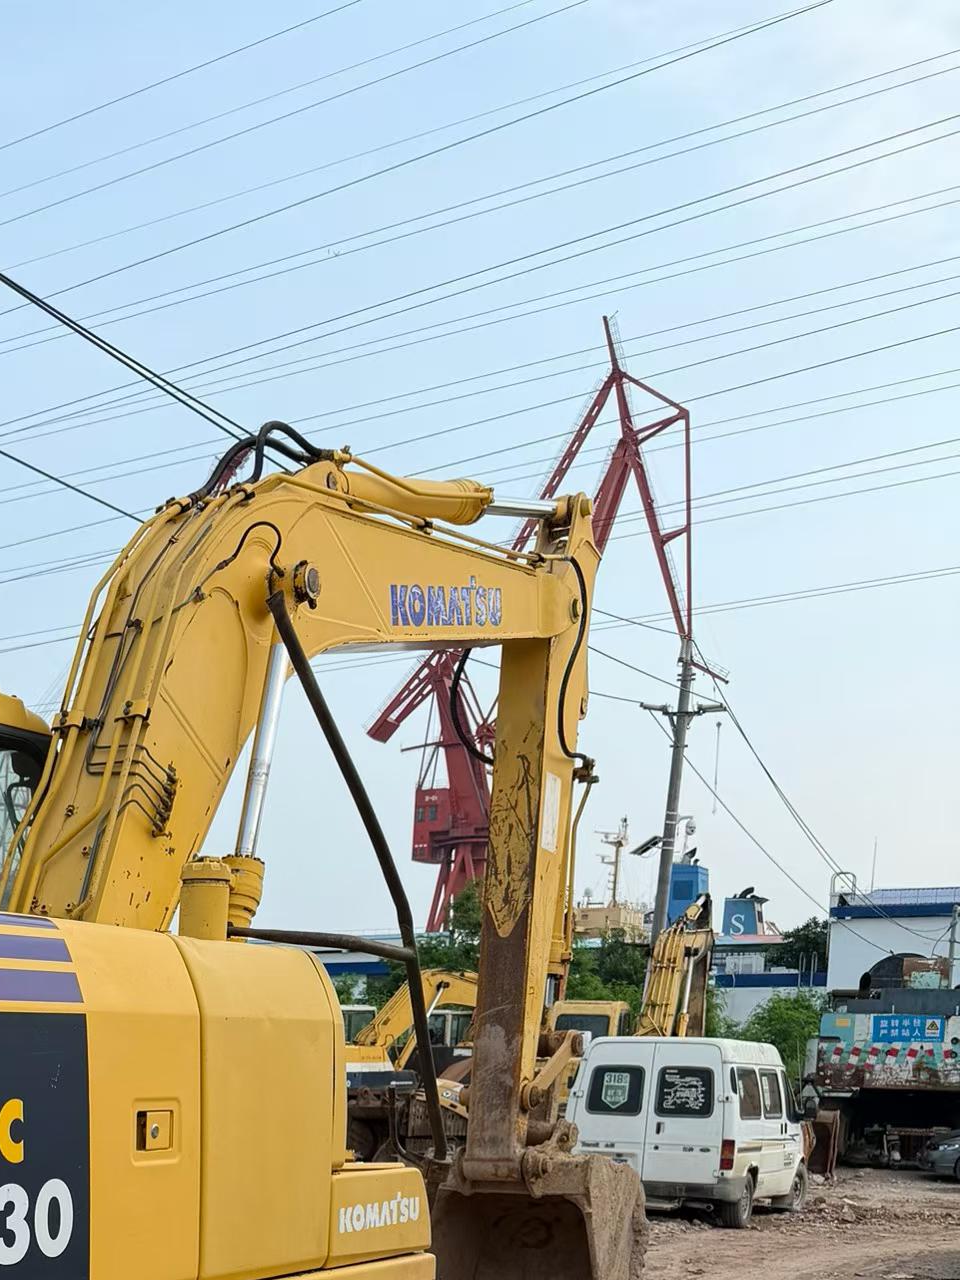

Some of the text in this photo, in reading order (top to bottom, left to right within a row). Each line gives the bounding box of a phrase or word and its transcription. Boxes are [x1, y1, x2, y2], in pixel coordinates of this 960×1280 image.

[390, 576, 503, 627] KOMATSU
[730, 914, 745, 936] S
[606, 1073, 623, 1084] 318
[338, 1191, 420, 1234] KOMATSU
